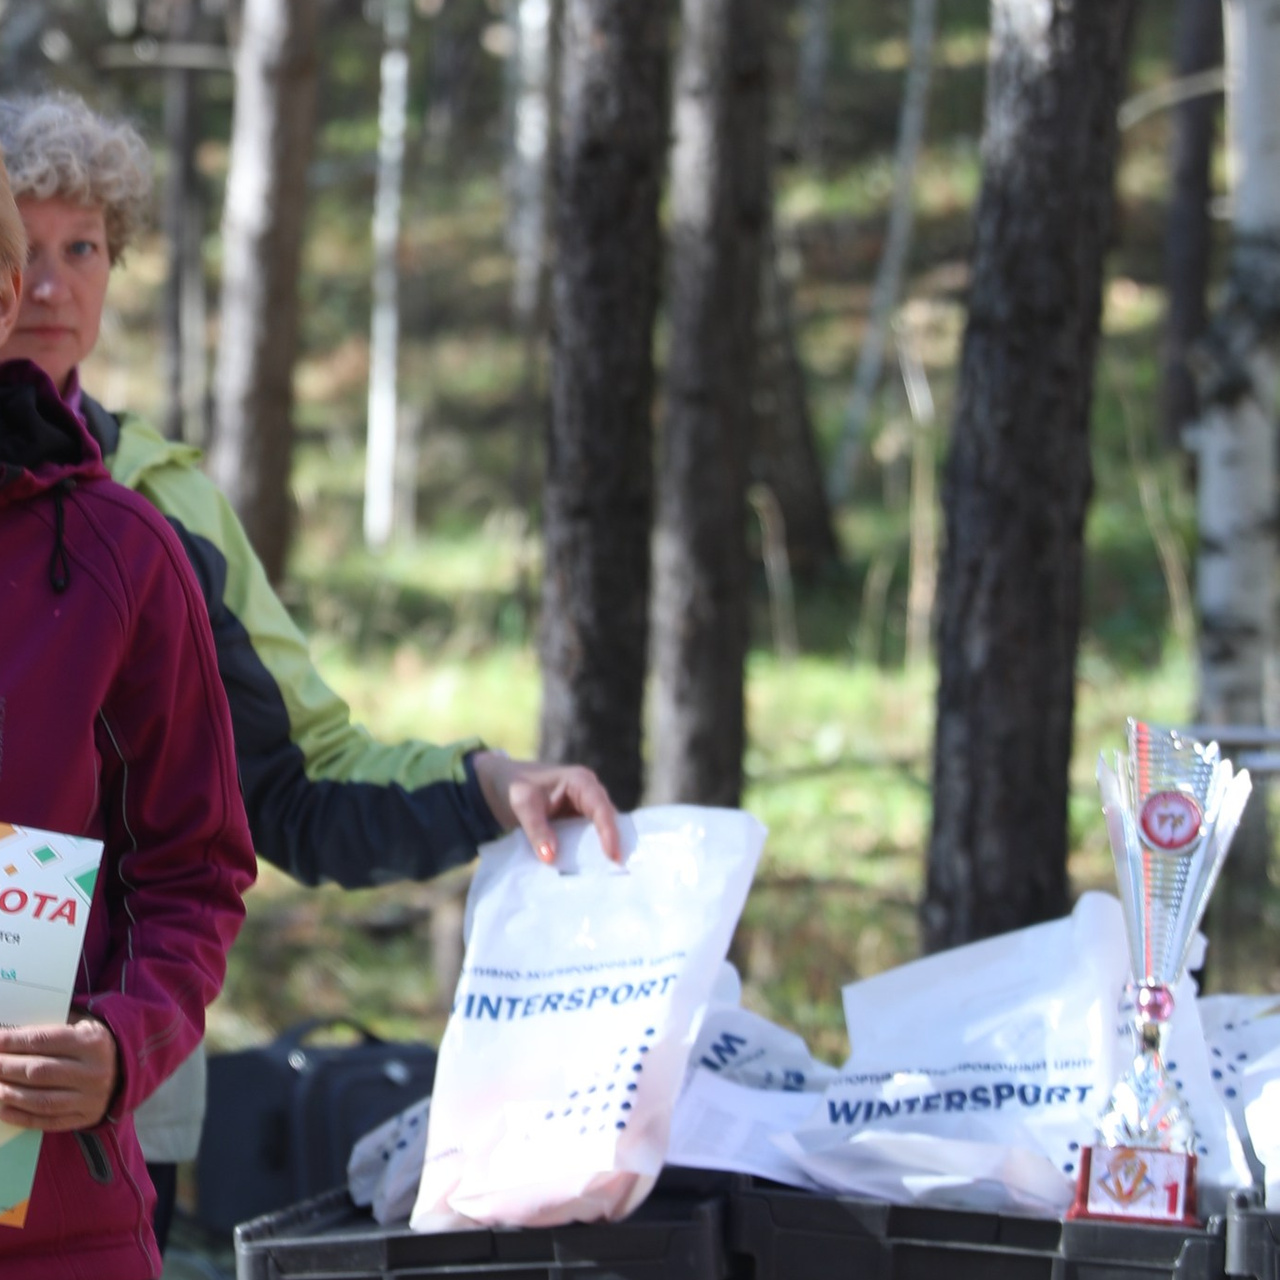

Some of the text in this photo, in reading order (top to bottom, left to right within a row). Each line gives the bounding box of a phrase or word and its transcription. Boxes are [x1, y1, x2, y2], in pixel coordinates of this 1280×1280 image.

[462, 973, 679, 1022] INTERSPORT
[827, 1081, 1095, 1125] WINTERSPORT
[1163, 1181, 1179, 1216] 1
